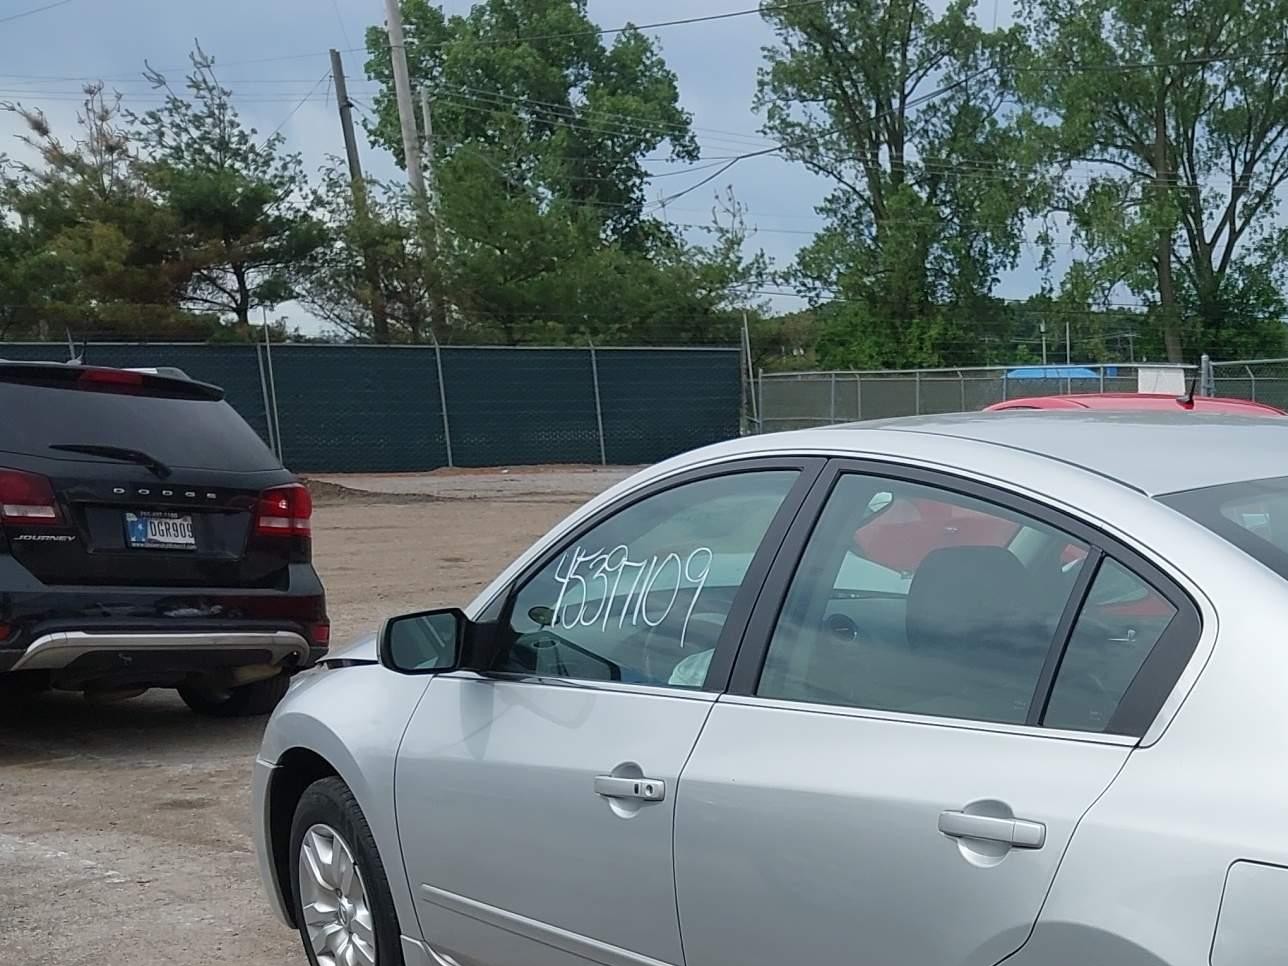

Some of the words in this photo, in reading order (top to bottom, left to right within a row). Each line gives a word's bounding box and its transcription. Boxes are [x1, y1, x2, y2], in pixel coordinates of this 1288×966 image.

[113, 487, 217, 499] DODGE
[149, 520, 195, 539] DGR909
[551, 544, 713, 648] 45397109
